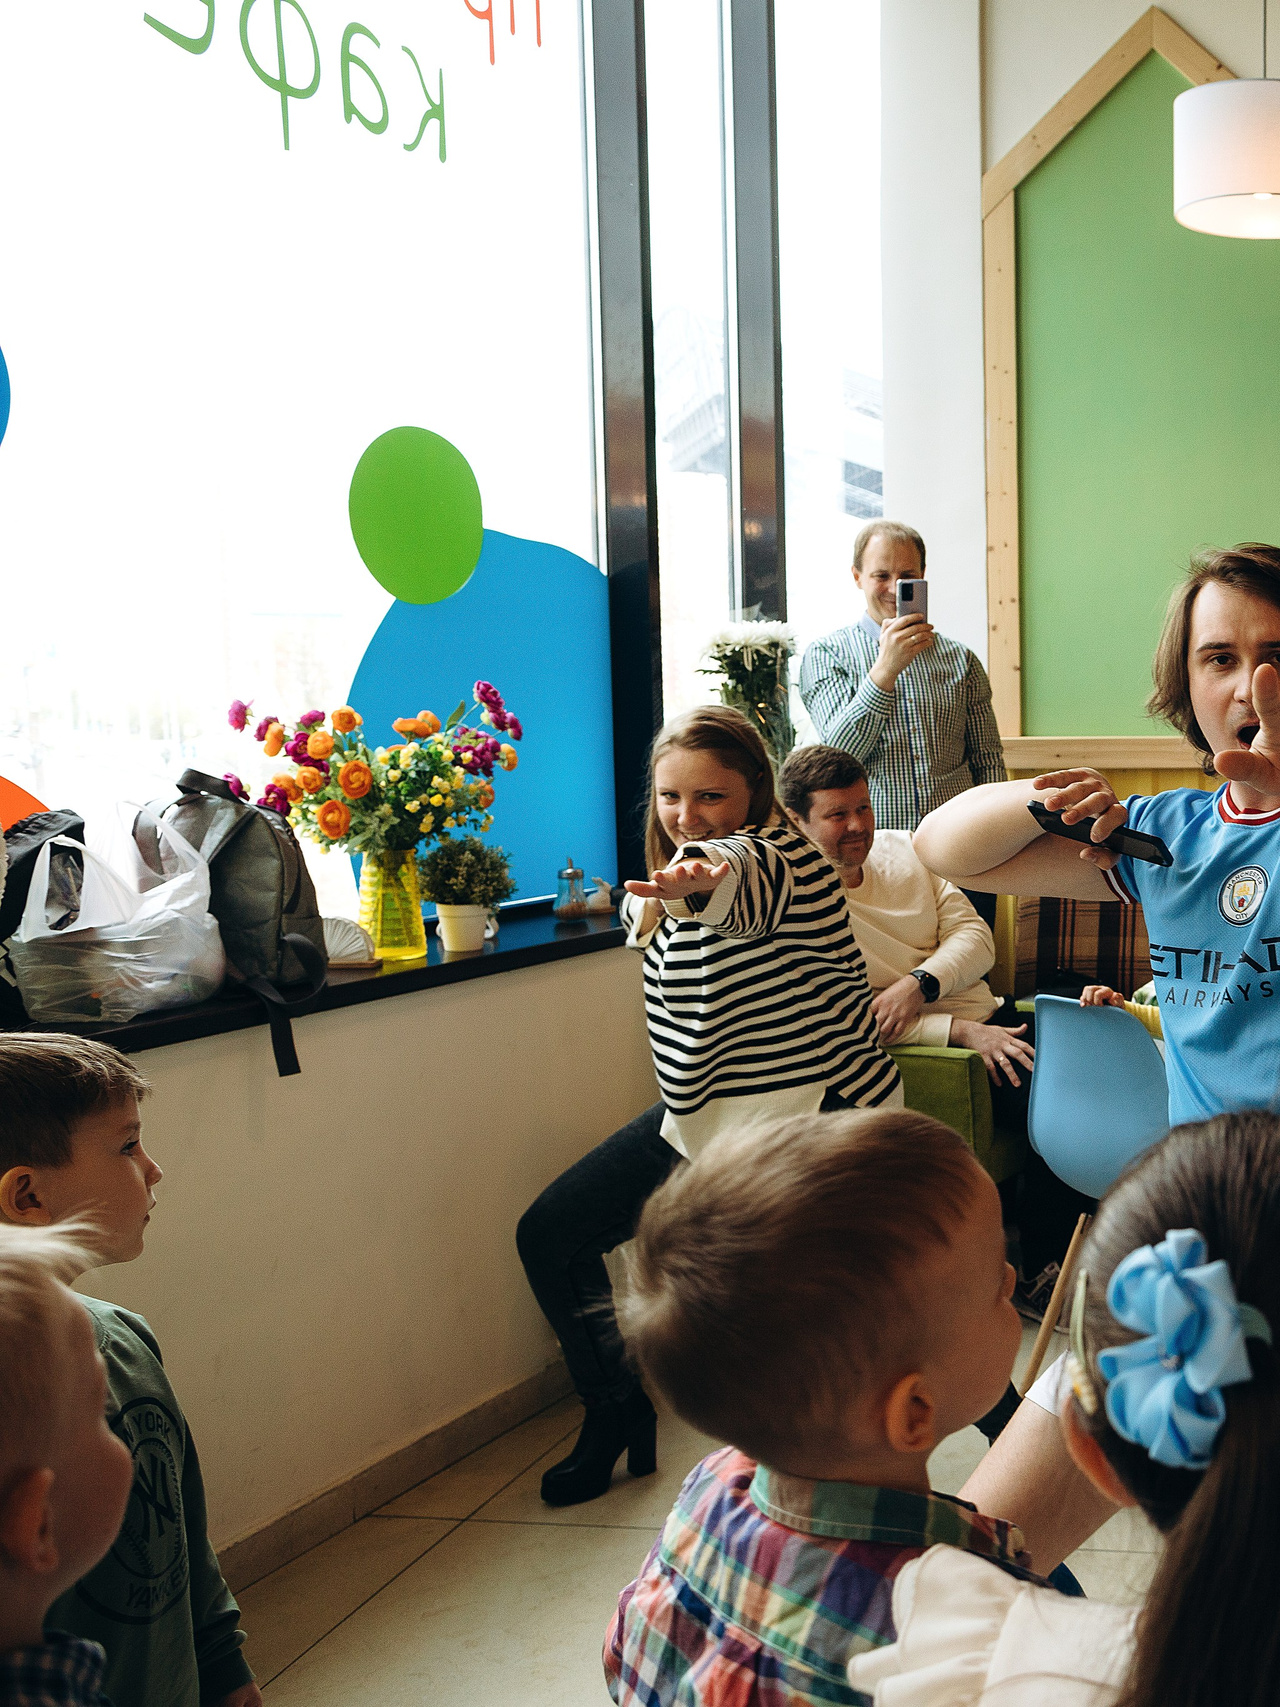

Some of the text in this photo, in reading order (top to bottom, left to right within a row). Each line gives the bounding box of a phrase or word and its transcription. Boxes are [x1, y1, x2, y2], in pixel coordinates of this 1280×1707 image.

[1226, 870, 1263, 890] MANCHESTER
[1235, 912, 1249, 920] CITY
[132, 1410, 172, 1445] YORK
